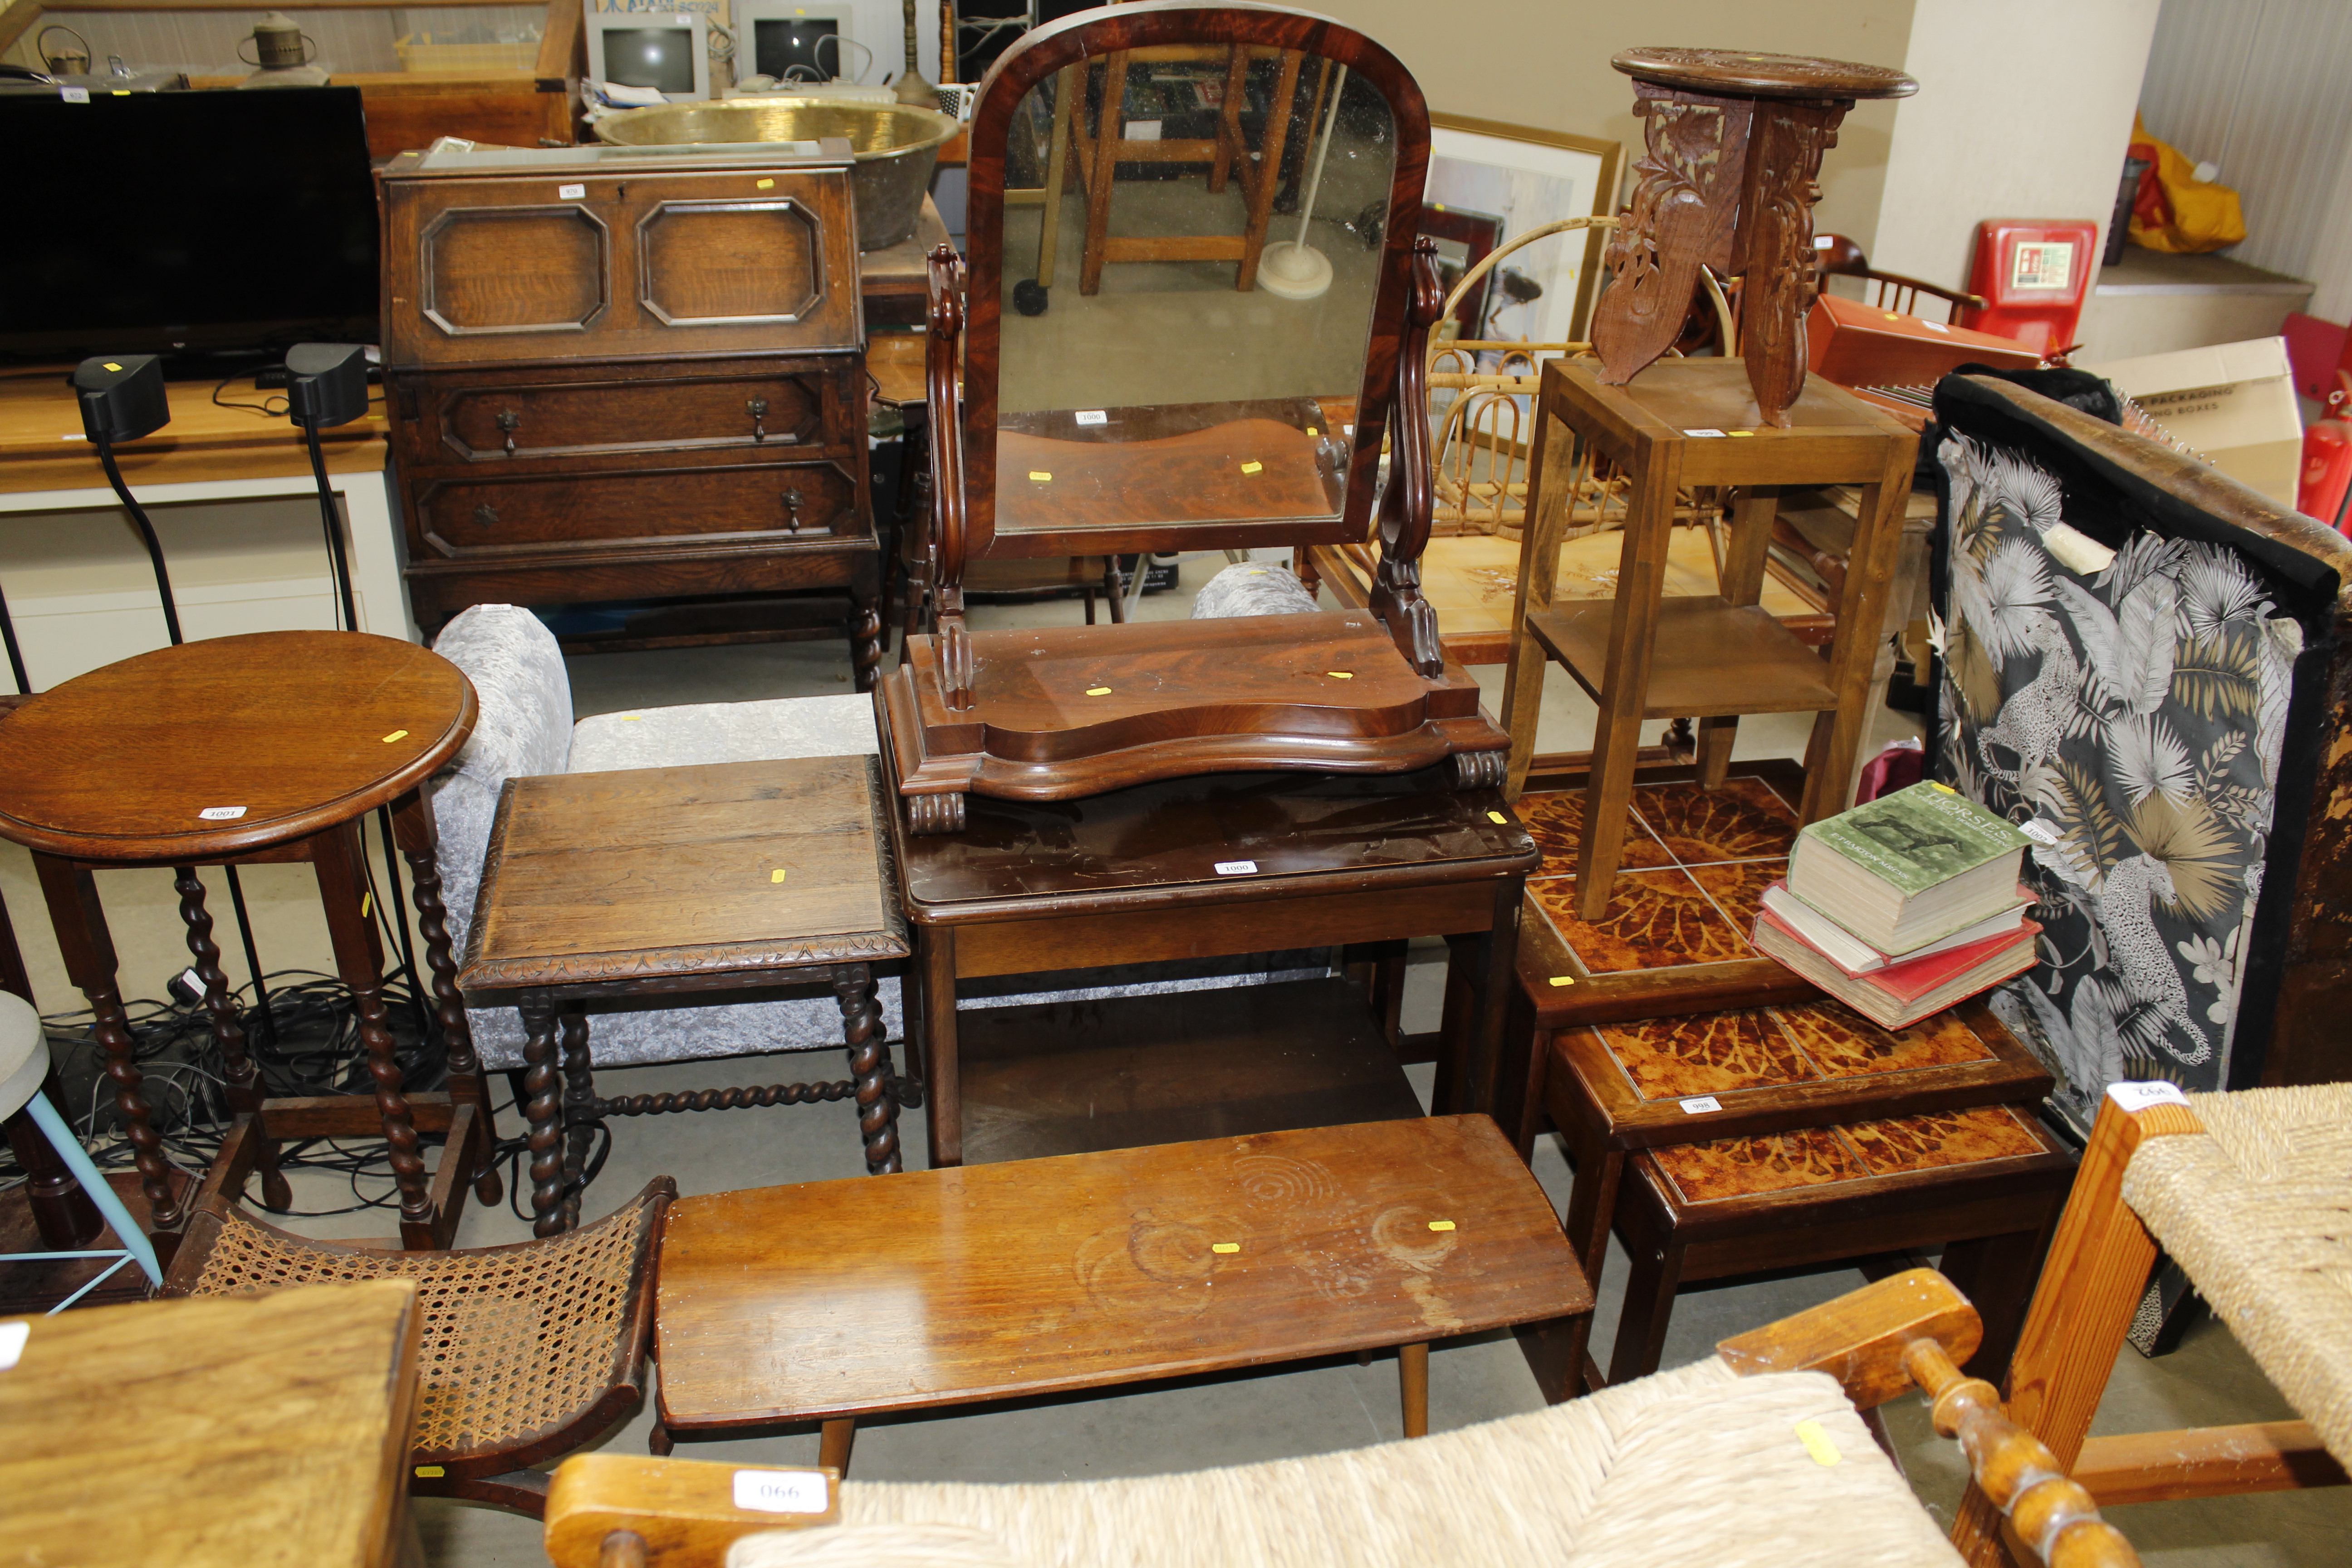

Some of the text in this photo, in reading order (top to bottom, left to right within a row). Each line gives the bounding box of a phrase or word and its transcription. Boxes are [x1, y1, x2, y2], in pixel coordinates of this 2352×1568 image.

[2151, 387, 2233, 404] PACKAGING
[2178, 402, 2219, 414] BOXES
[1917, 795, 1955, 818] PRACTICAL
[1926, 792, 2012, 839] HORSES
[2027, 828, 2048, 842] 1002
